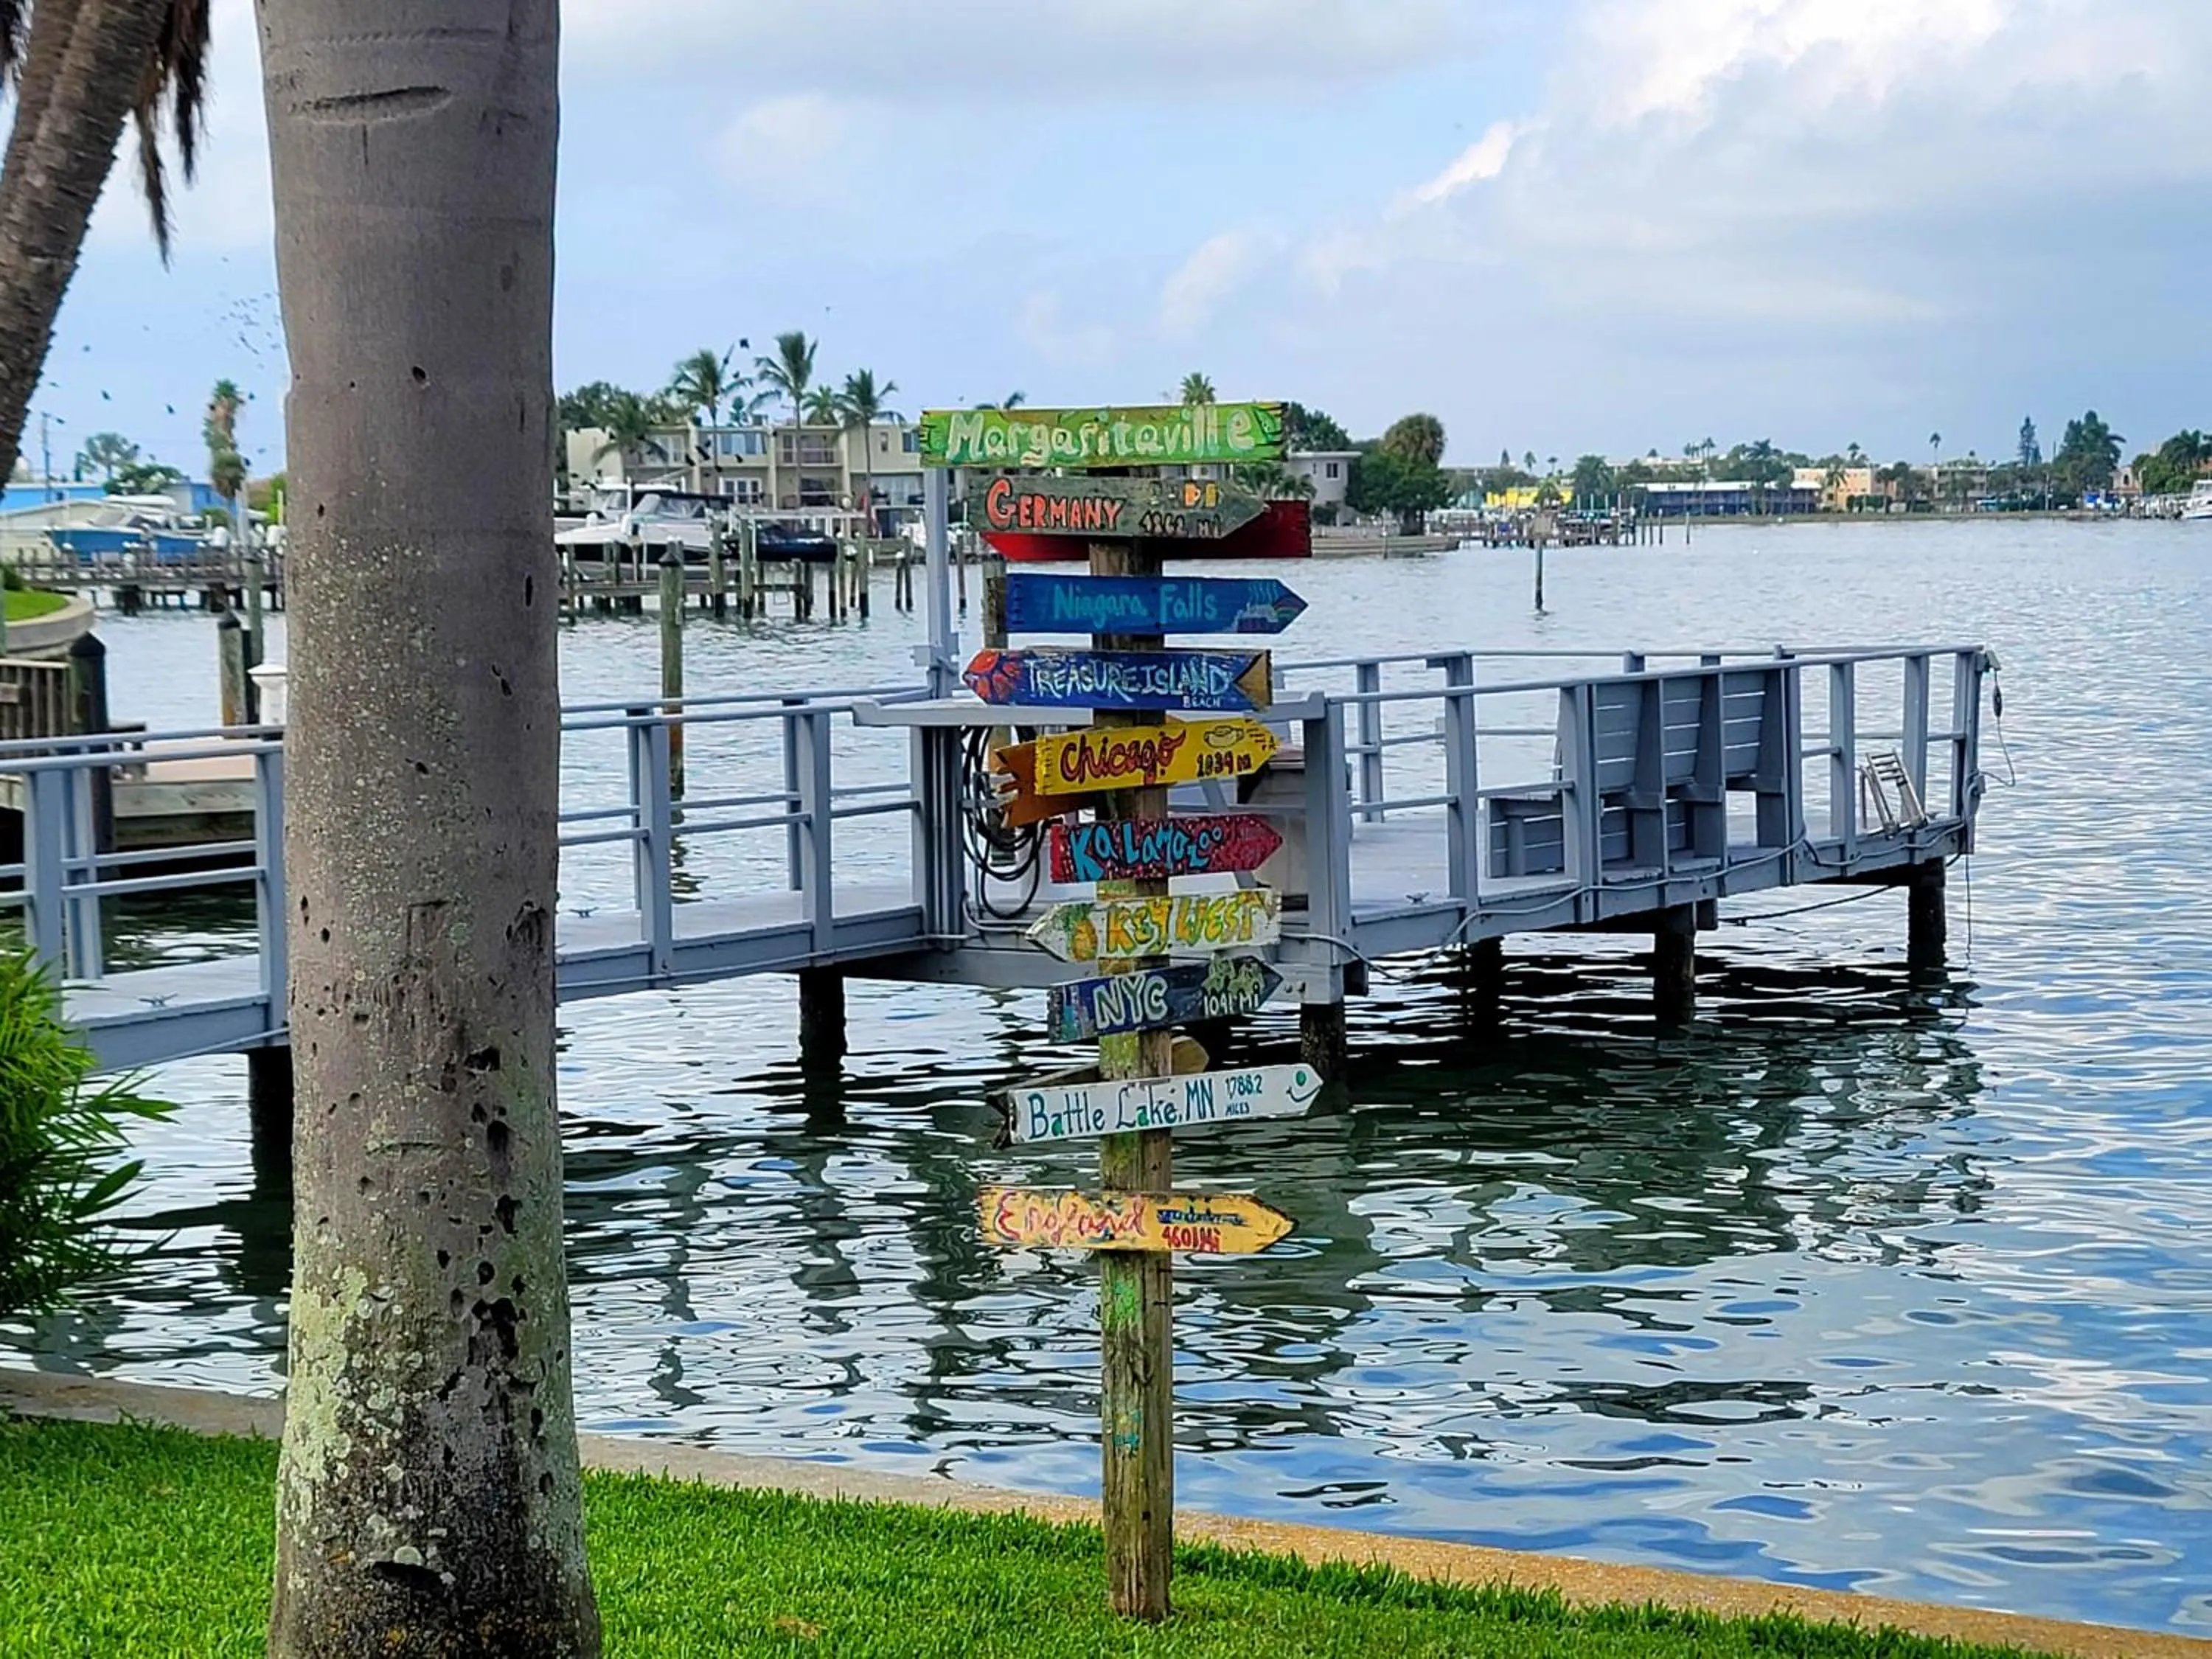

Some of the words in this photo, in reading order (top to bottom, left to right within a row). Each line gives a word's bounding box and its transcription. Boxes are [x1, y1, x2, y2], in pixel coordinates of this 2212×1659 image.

[946, 405, 1256, 466] Margaritaville
[986, 478, 1127, 531] GERMANY
[1052, 582, 1148, 629] Niagara
[1158, 582, 1218, 625] Falls
[1023, 658, 1140, 703] TREASURE
[1141, 655, 1230, 696] ISLAND
[1183, 696, 1221, 709] BEACH
[1107, 897, 1173, 955] KEY
[1175, 891, 1262, 947] WEST
[1092, 973, 1169, 1030] NYC
[1027, 1091, 1105, 1141] Battle
[1185, 1078, 1217, 1121] MN
[996, 1191, 1147, 1246] England
